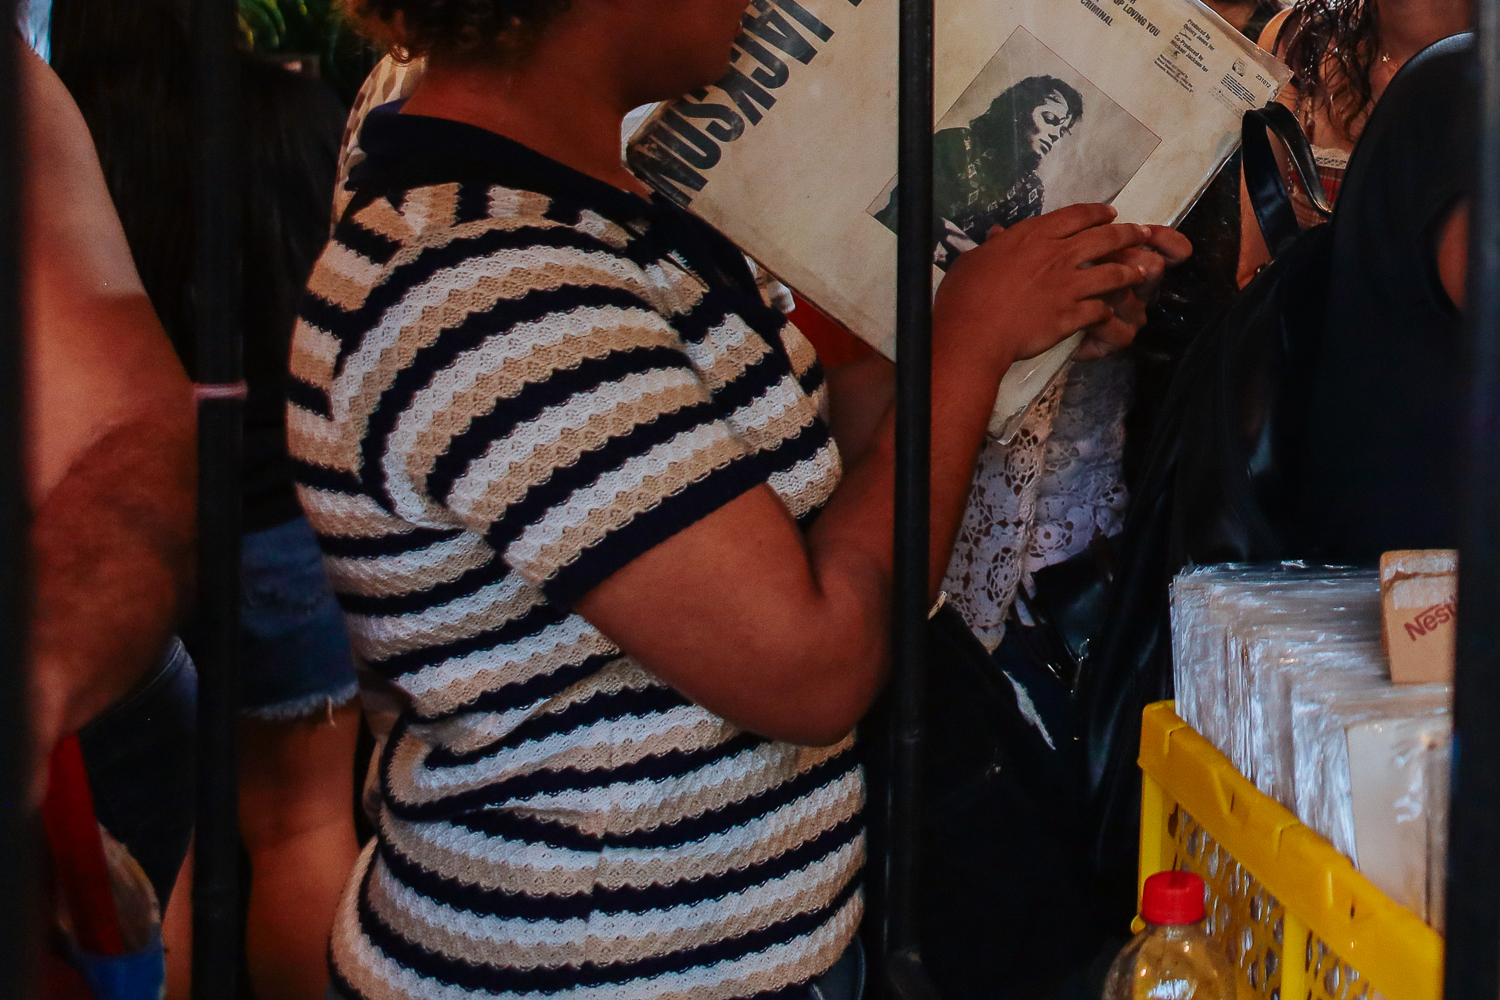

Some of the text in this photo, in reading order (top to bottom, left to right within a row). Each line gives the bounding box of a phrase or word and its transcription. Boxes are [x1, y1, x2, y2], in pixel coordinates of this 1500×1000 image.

[1122, 3, 1148, 27] LOVING
[1145, 22, 1160, 37] YOU
[1187, 19, 1207, 37] Produced
[1174, 34, 1201, 59] Co-Produced
[1183, 23, 1198, 37] Quincy
[1196, 35, 1210, 47] Jones
[1170, 39, 1187, 55] Michael
[1185, 53, 1203, 68] Jackson
